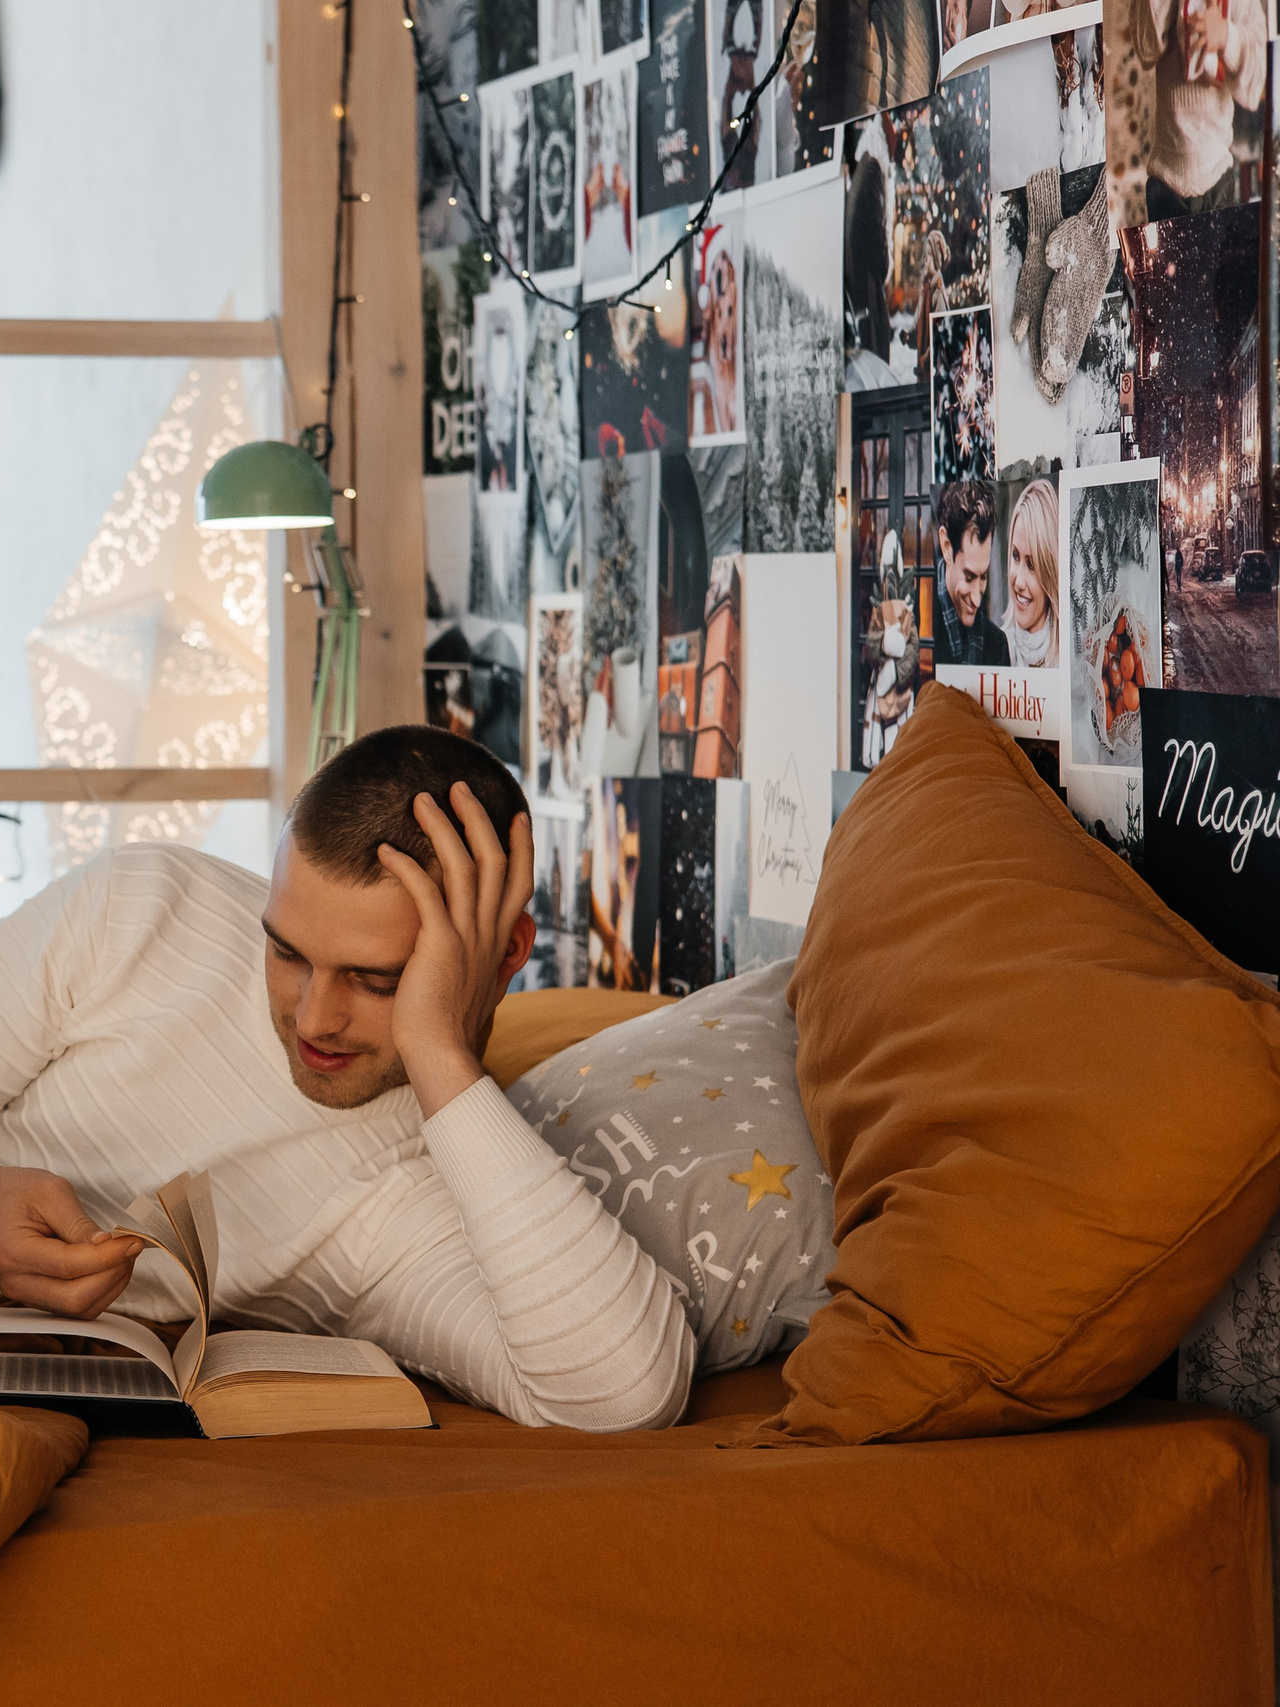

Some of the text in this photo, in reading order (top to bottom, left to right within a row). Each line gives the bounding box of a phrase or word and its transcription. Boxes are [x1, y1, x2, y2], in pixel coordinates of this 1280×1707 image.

[978, 672, 1046, 737] Holiday
[763, 779, 797, 839] Merry
[1158, 738, 1280, 874] Magi
[757, 832, 802, 887] Christmas
